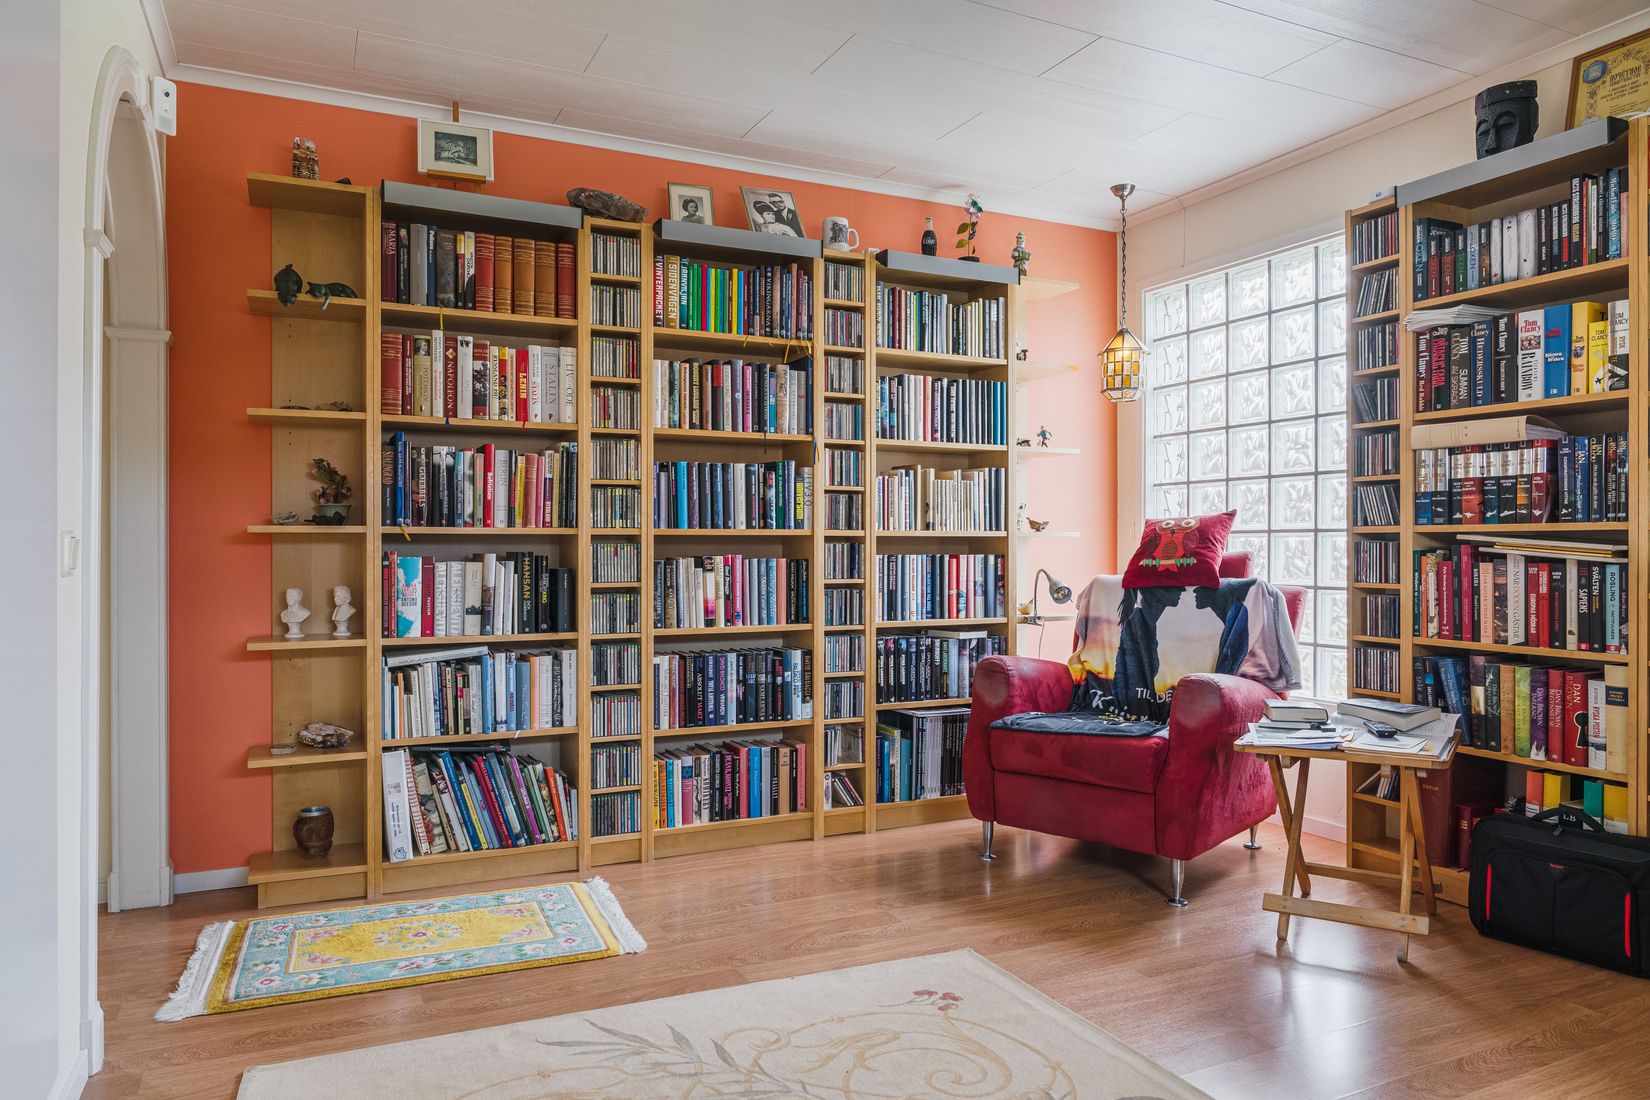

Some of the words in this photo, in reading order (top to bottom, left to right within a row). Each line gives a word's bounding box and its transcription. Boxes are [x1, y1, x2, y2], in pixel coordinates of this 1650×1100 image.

[923, 237, 936, 245] Coke
[1471, 328, 1489, 337] Clancy
[1474, 322, 1487, 330] Tom
[1498, 316, 1508, 331] Tom
[1520, 325, 1541, 333] Clancy
[1419, 333, 1429, 351] Tom
[1452, 332, 1460, 361] CLANCY
[1459, 336, 1469, 354] TOM
[1497, 332, 1508, 352] Clancy
[1591, 333, 1608, 342] CLANCY
[565, 363, 574, 379] LIV
[1417, 352, 1429, 378] Clancy
[1452, 365, 1459, 375] AV
[1476, 337, 1485, 397] HEDERSSKULD
[1521, 352, 1535, 391] RAINBOW
[519, 372, 527, 399] LENIN
[548, 363, 556, 405] STALIN
[1432, 370, 1446, 388] FARA
[1459, 368, 1468, 399] SUMMAN
[382, 450, 393, 485] STALINGRAD
[522, 557, 530, 599] HANSAN
[1513, 570, 1521, 585] NÄR
[1592, 566, 1600, 595] SVÄLTEN
[1579, 588, 1588, 613] SAPIENS
[1573, 683, 1581, 703] DAN
